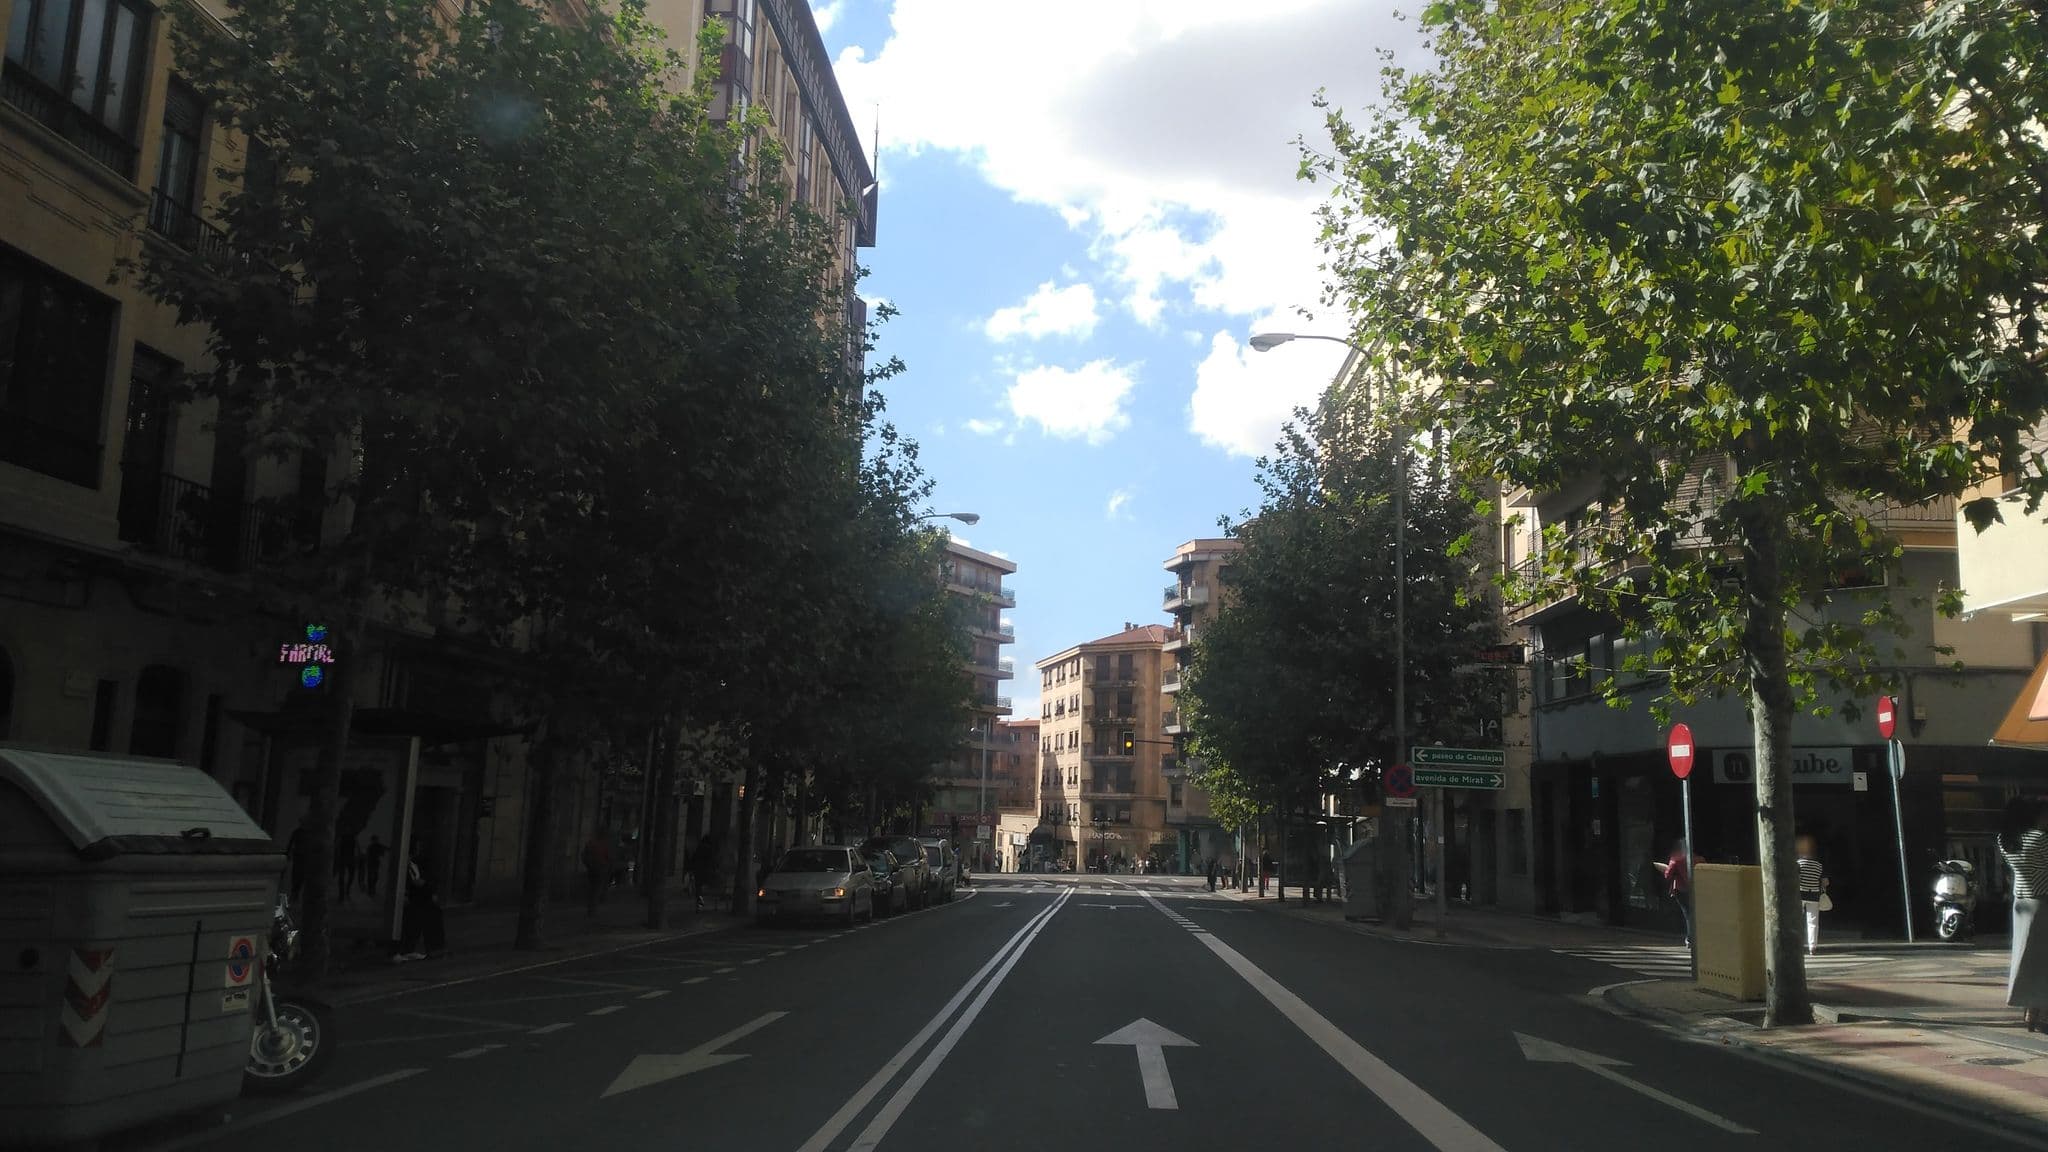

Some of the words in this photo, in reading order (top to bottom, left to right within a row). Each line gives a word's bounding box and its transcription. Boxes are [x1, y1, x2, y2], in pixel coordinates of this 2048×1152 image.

[1431, 753, 1453, 761] paseo
[1455, 752, 1465, 760] de
[1466, 753, 1503, 763] Canalejas
[1791, 753, 1841, 774] ube
[1415, 774, 1447, 782] avenida
[1449, 775, 1459, 783] de
[1462, 776, 1484, 784] Mirat
